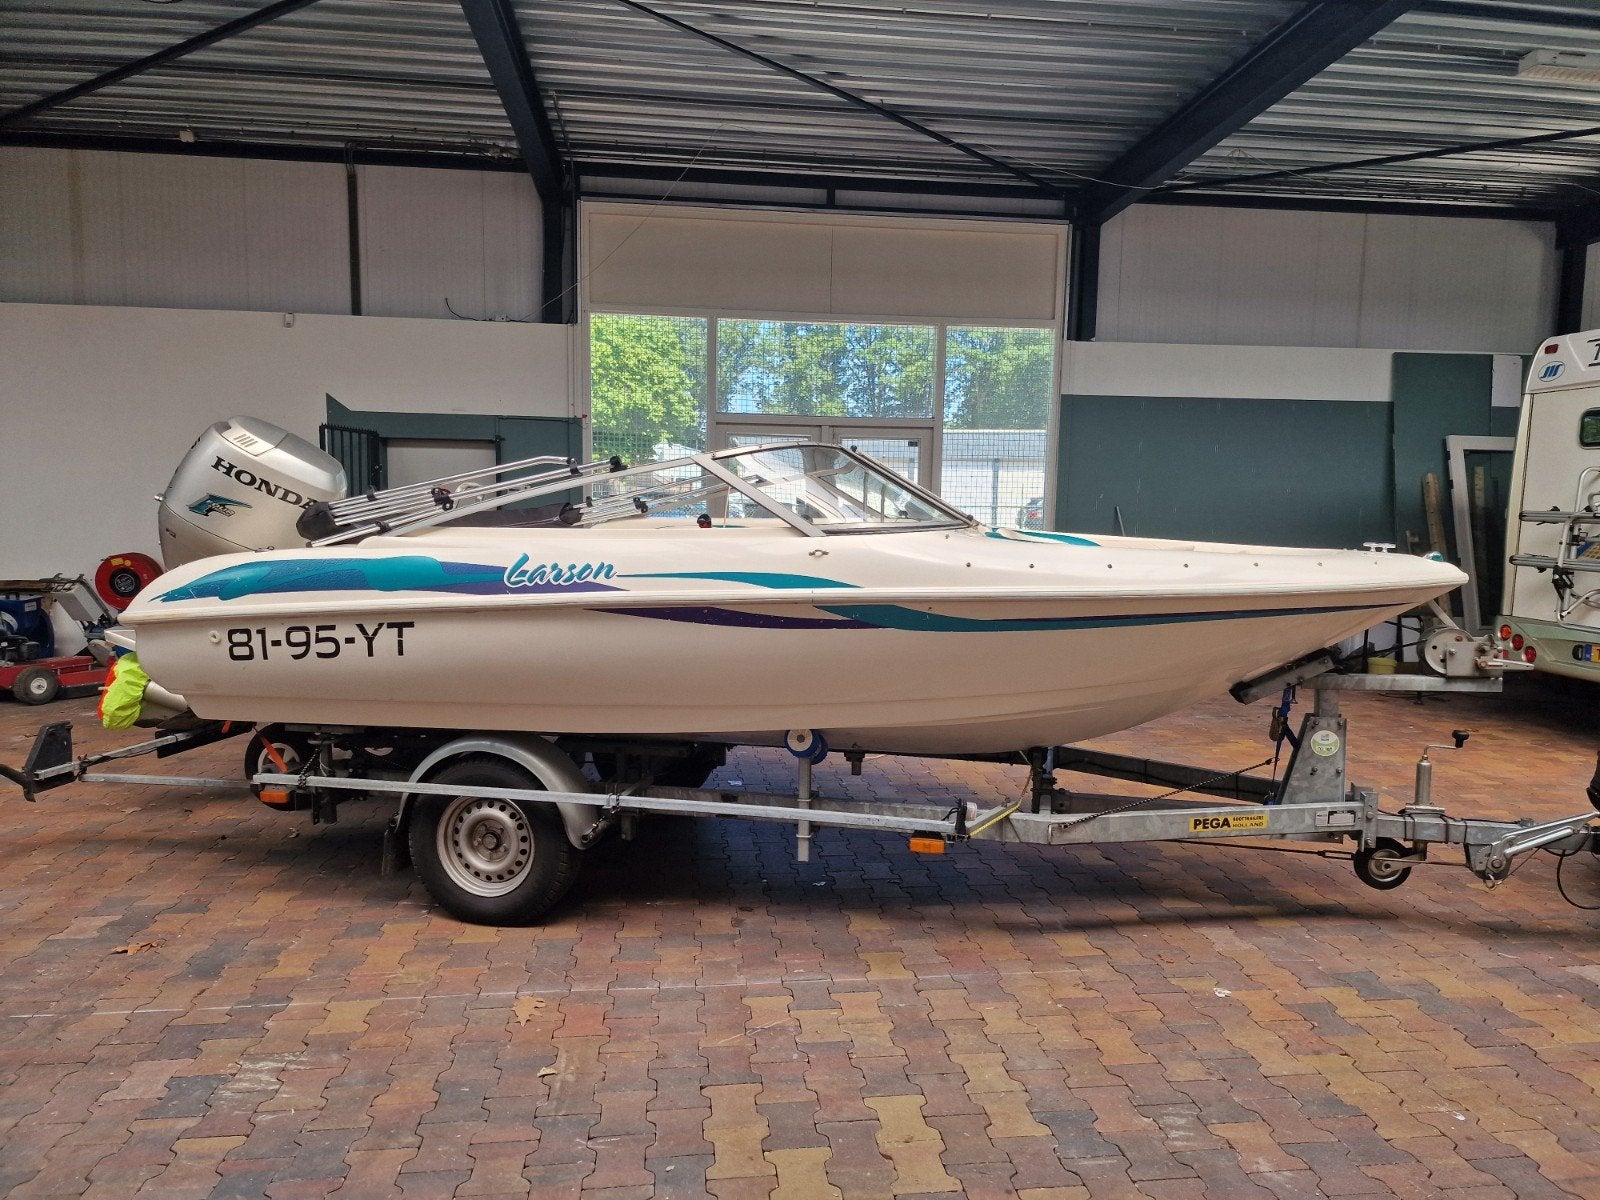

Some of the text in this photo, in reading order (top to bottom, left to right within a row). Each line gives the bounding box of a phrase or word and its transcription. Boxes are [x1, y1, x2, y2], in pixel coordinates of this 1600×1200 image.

[504, 552, 617, 588] Larson
[227, 621, 415, 661] 81-95-YT
[1193, 817, 1231, 830] PEGA
